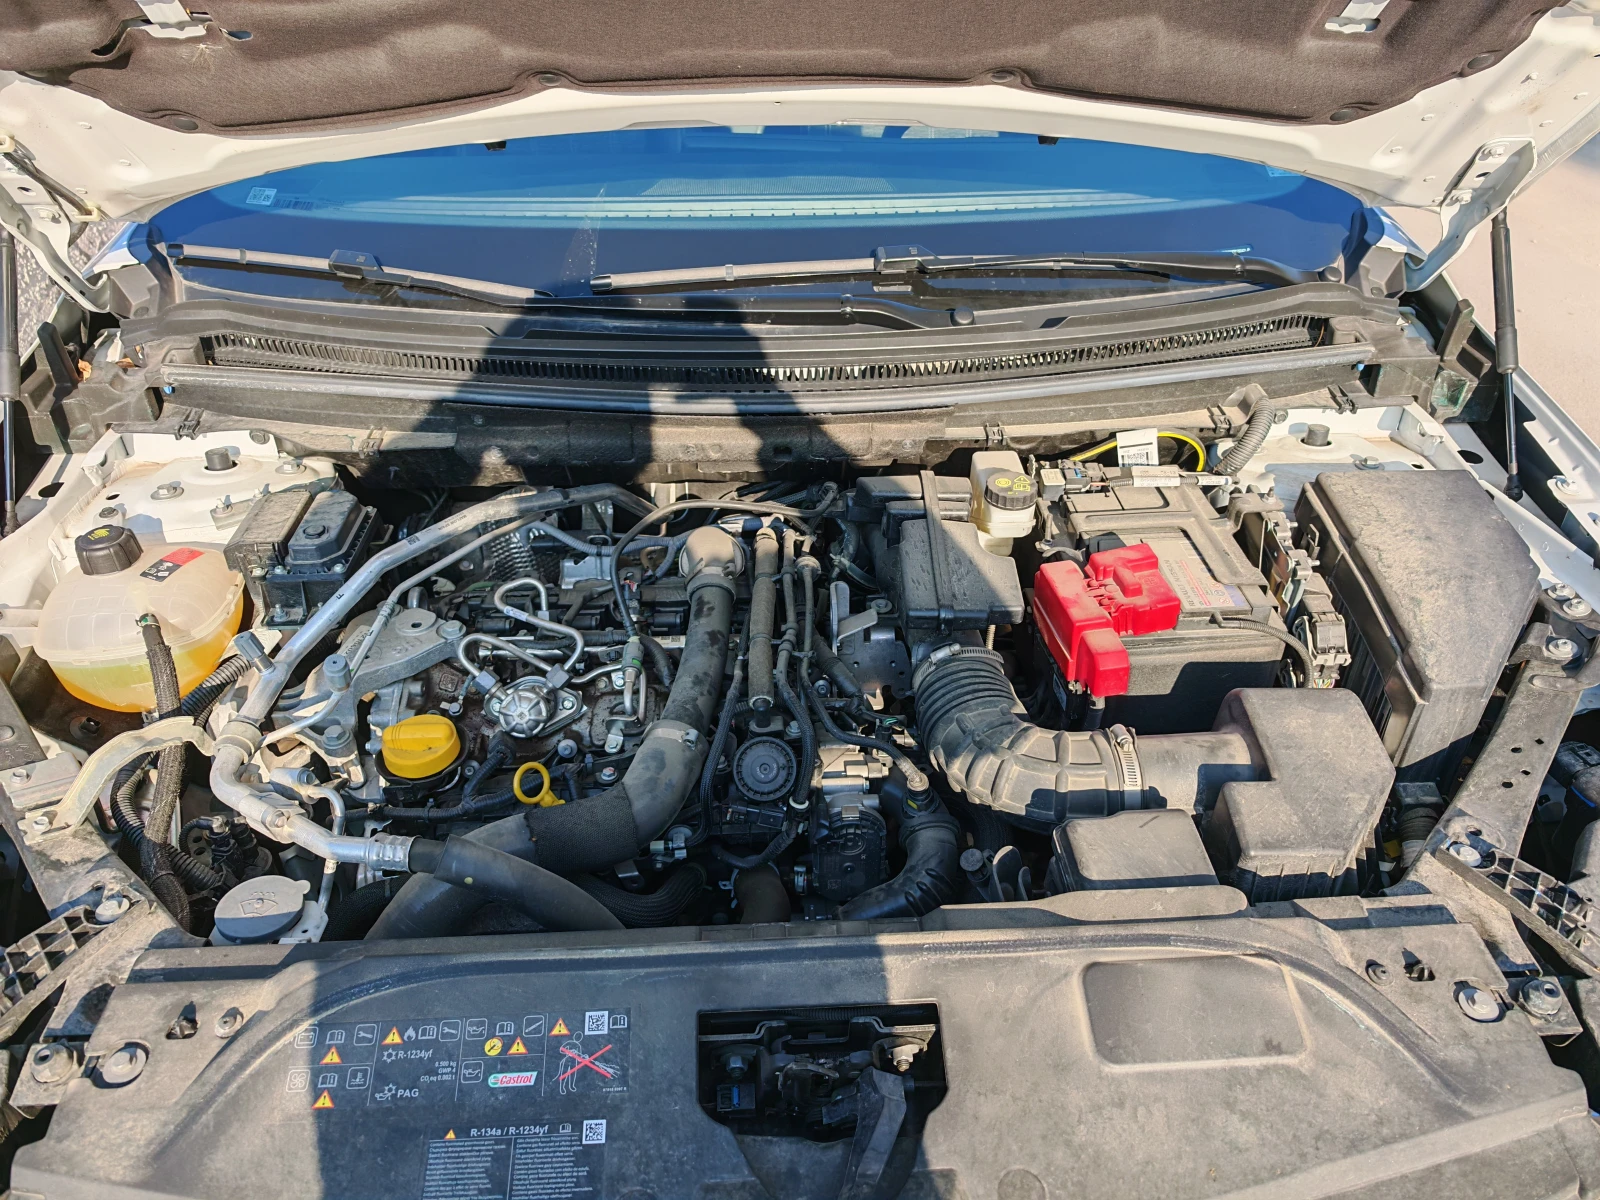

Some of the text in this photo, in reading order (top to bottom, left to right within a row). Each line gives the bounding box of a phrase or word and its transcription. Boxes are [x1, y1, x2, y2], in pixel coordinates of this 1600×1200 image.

[397, 1049, 434, 1060] R-1234yf
[500, 1073, 533, 1085] Castrol
[397, 1088, 419, 1099] PAG
[470, 1127, 502, 1137] R-134a
[508, 1125, 549, 1136] R-1234yf
